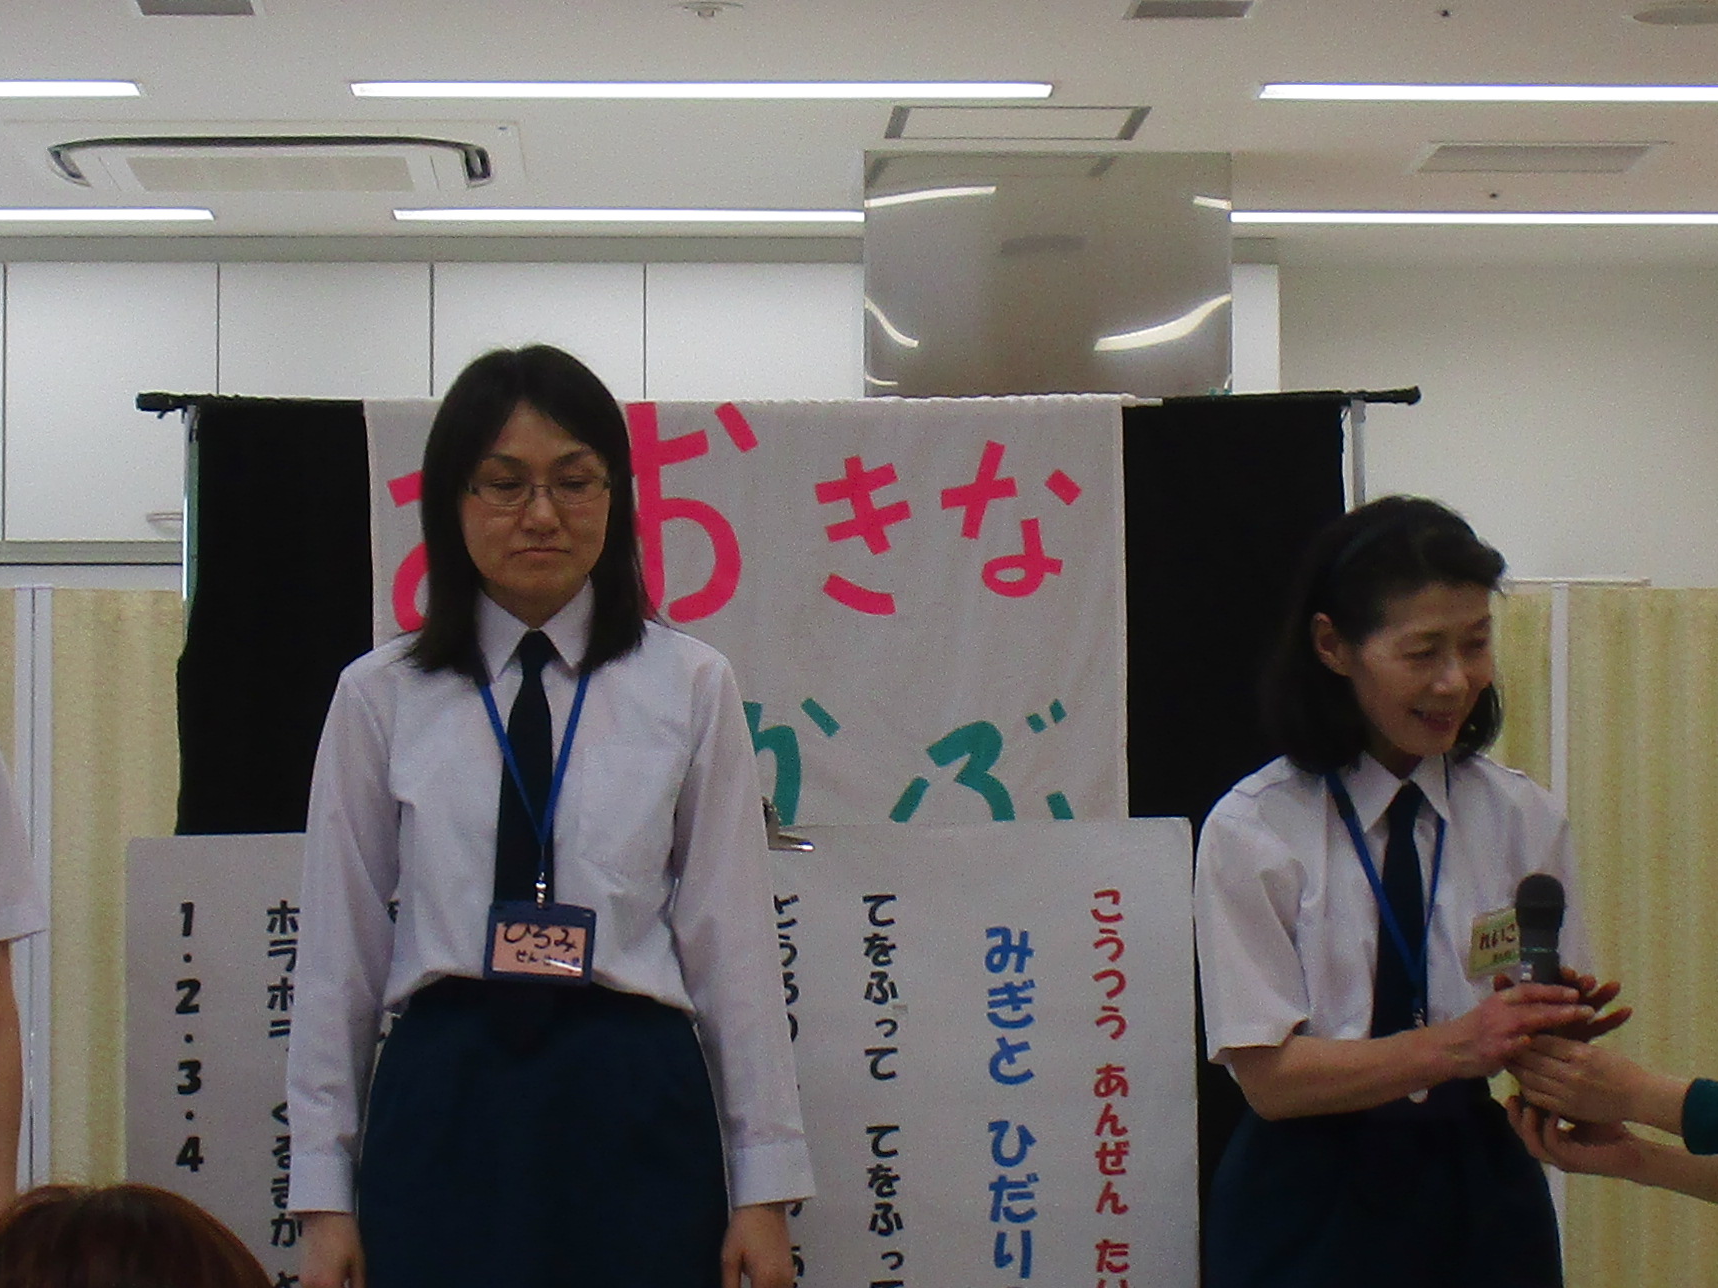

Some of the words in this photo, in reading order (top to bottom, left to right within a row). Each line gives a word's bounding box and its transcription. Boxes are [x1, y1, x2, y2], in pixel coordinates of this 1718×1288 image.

[774, 894, 800, 1042] どうろ
[862, 894, 899, 1081] てをふって
[985, 926, 1036, 1085] みぎと
[1091, 888, 1127, 1040] こうつう
[1093, 1064, 1130, 1214] あんぜん
